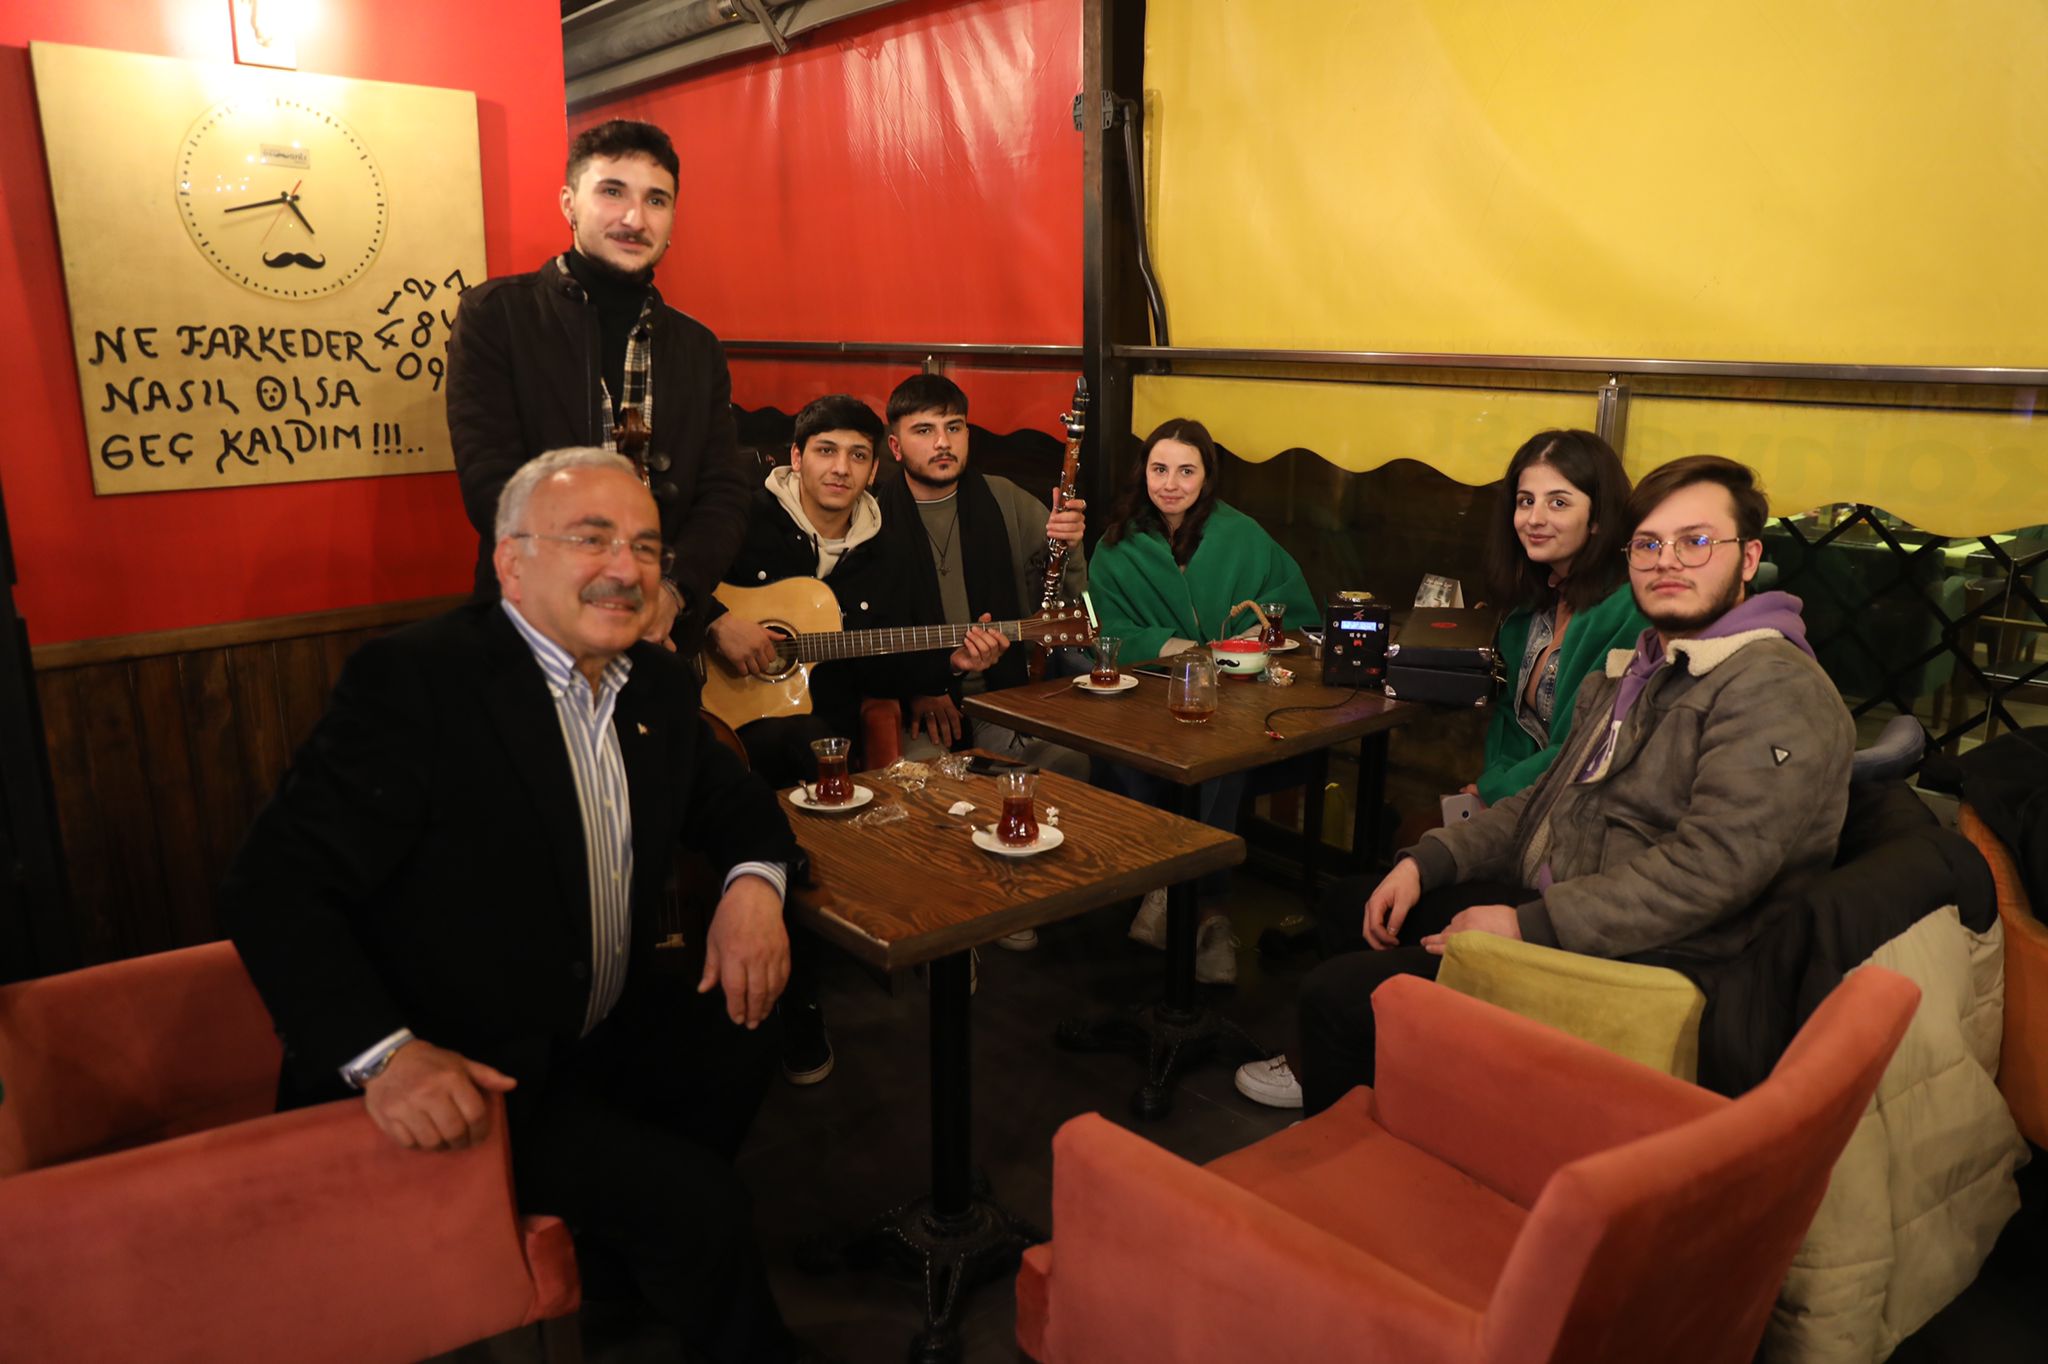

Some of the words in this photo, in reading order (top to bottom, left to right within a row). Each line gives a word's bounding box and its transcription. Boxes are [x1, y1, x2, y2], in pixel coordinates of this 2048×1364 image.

[88, 326, 159, 366] NE
[175, 324, 381, 373] FARKEDER
[100, 376, 240, 416] NASIL
[255, 375, 361, 417] OLSA
[100, 432, 194, 471] GEÇ
